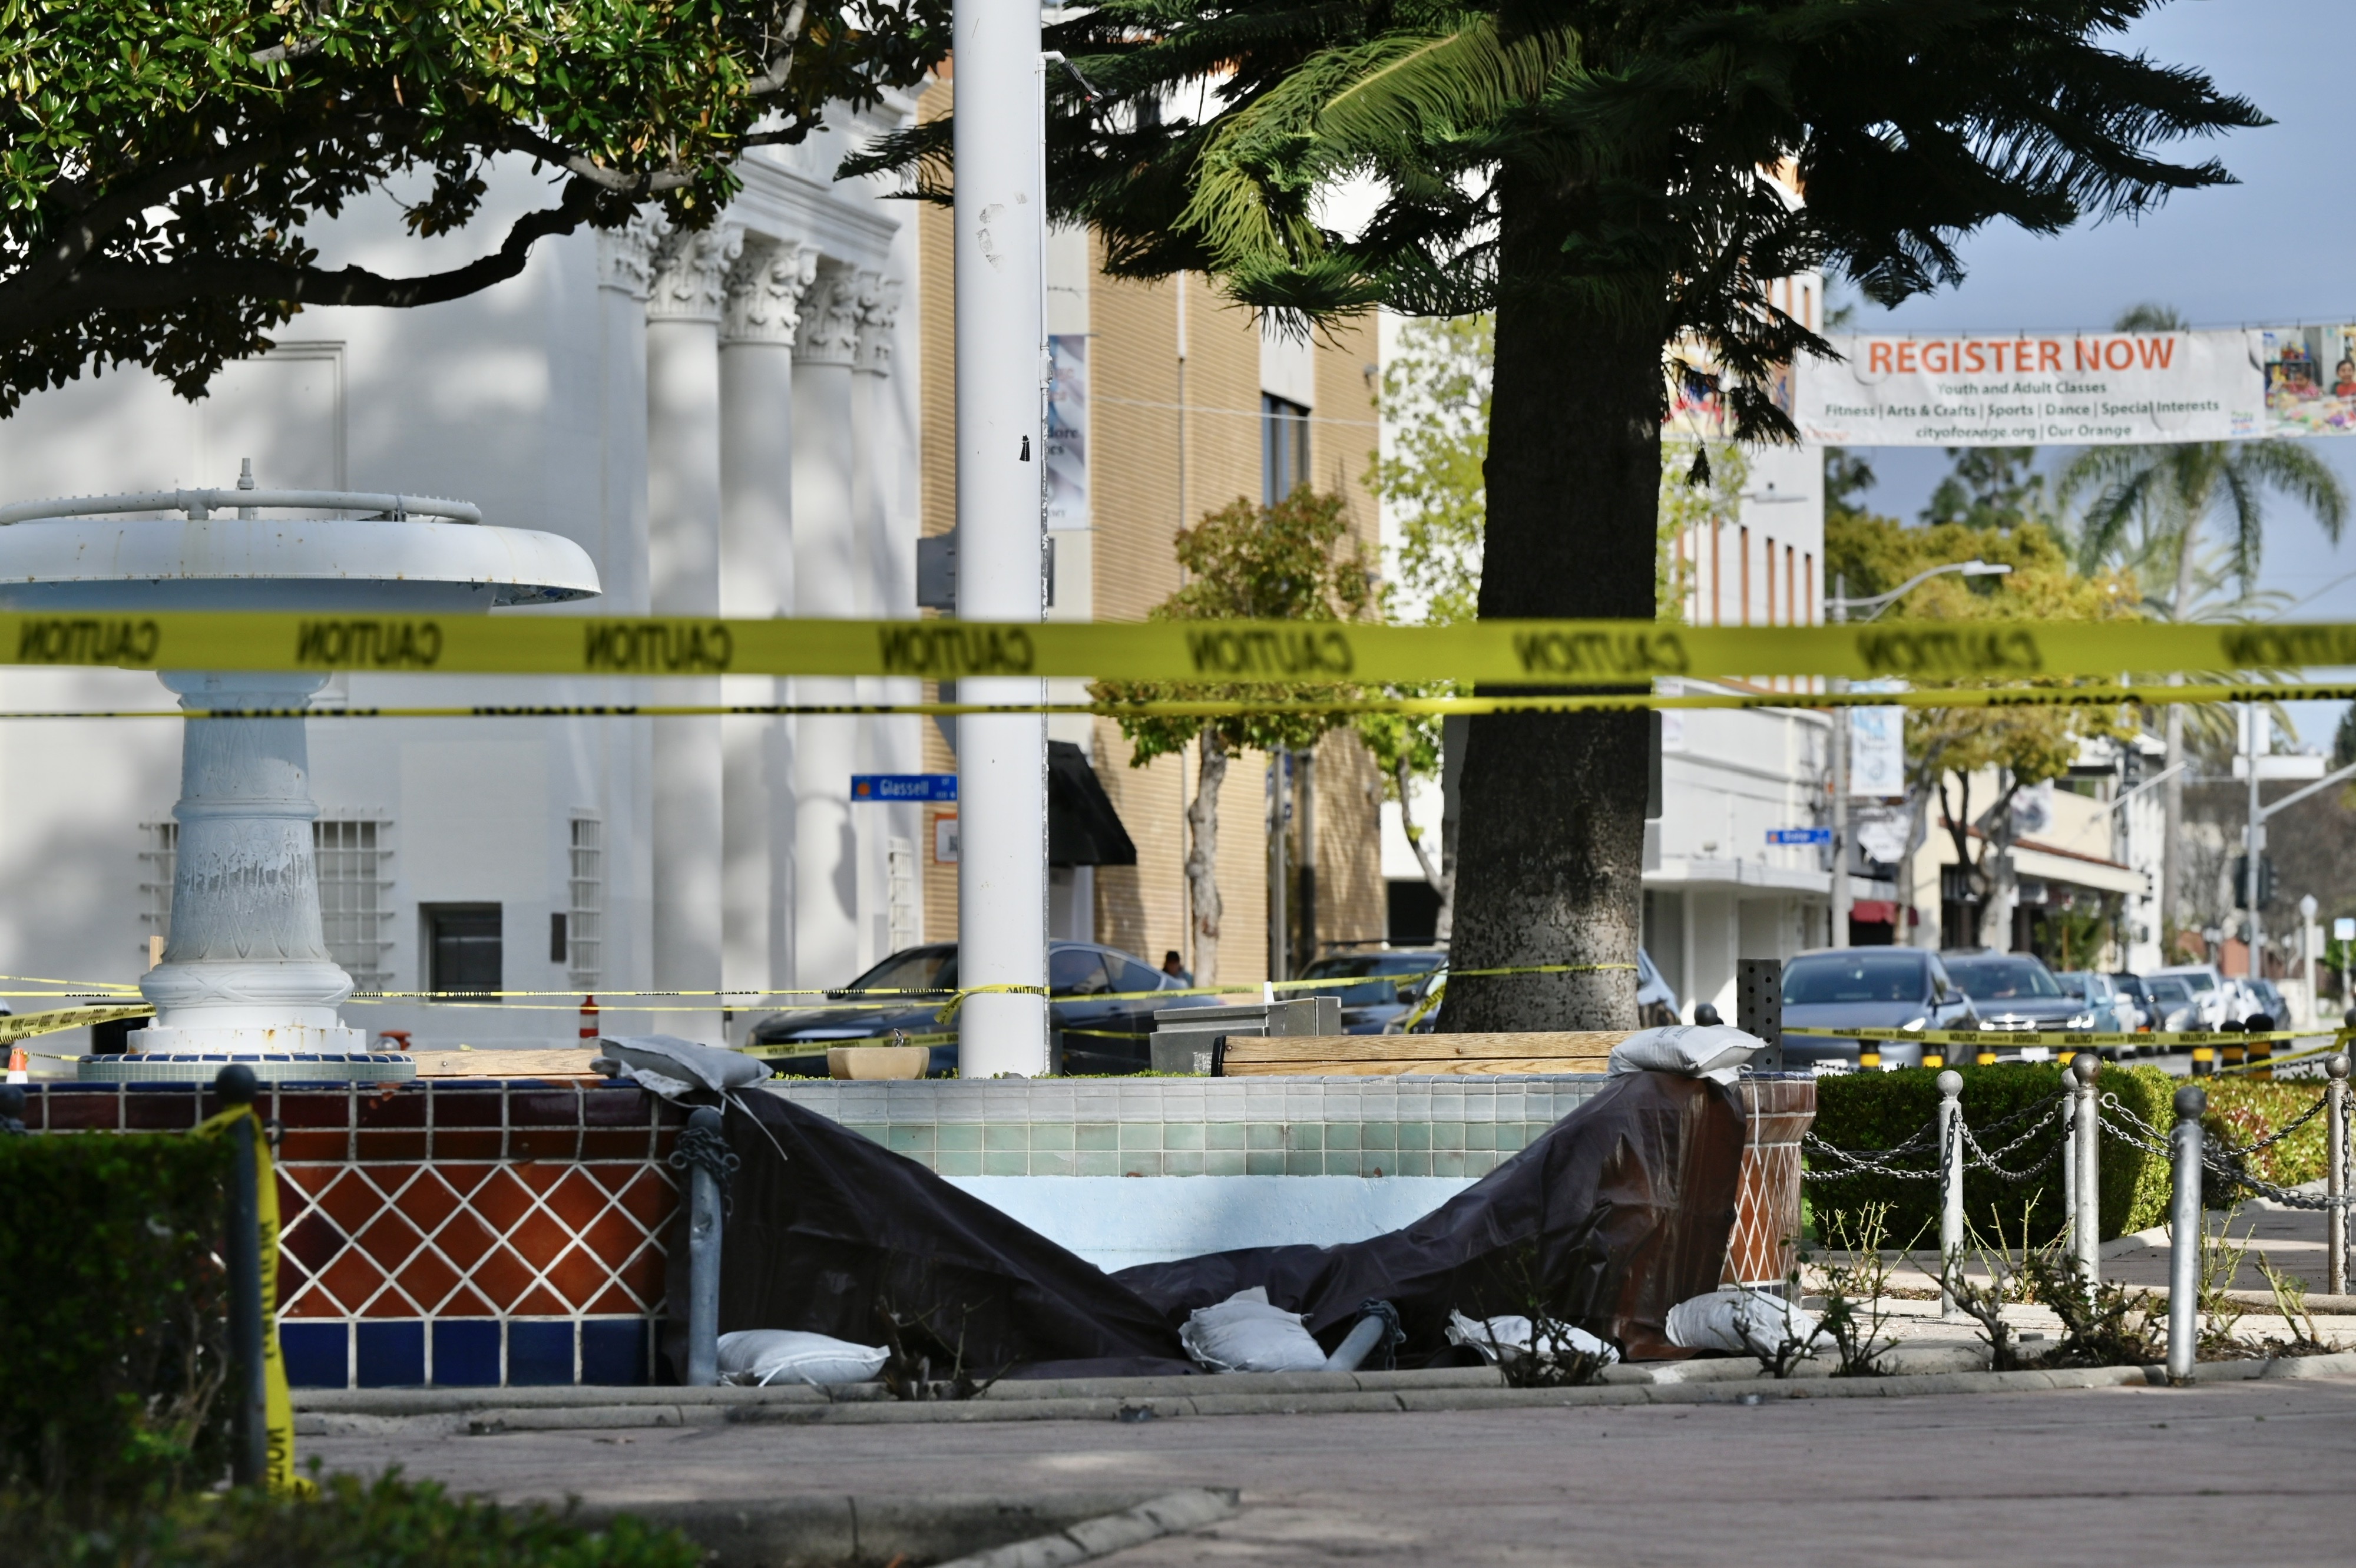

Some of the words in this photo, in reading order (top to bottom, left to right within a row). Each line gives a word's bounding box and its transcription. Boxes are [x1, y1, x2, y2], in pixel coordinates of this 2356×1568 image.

[1869, 340, 2063, 374] REGISTER
[2075, 337, 2175, 371] NOW
[1937, 383, 1978, 395] Youth
[1982, 382, 2009, 395] and
[2013, 382, 2052, 394] Adult
[2056, 382, 2107, 393] Classes
[1826, 403, 1875, 417] Fitness
[1887, 405, 1916, 417] Arts
[1919, 405, 1930, 416] &
[1934, 404, 1976, 417] Crafts
[1987, 404, 2033, 419] Sports
[2046, 403, 2090, 416] Dance
[2101, 401, 2153, 416] Special
[2157, 399, 2219, 412] Interests
[1915, 425, 2036, 441] cityoforange.org
[2048, 425, 2073, 437] Our
[2078, 425, 2132, 439] Orange
[879, 779, 929, 796] Glassell
